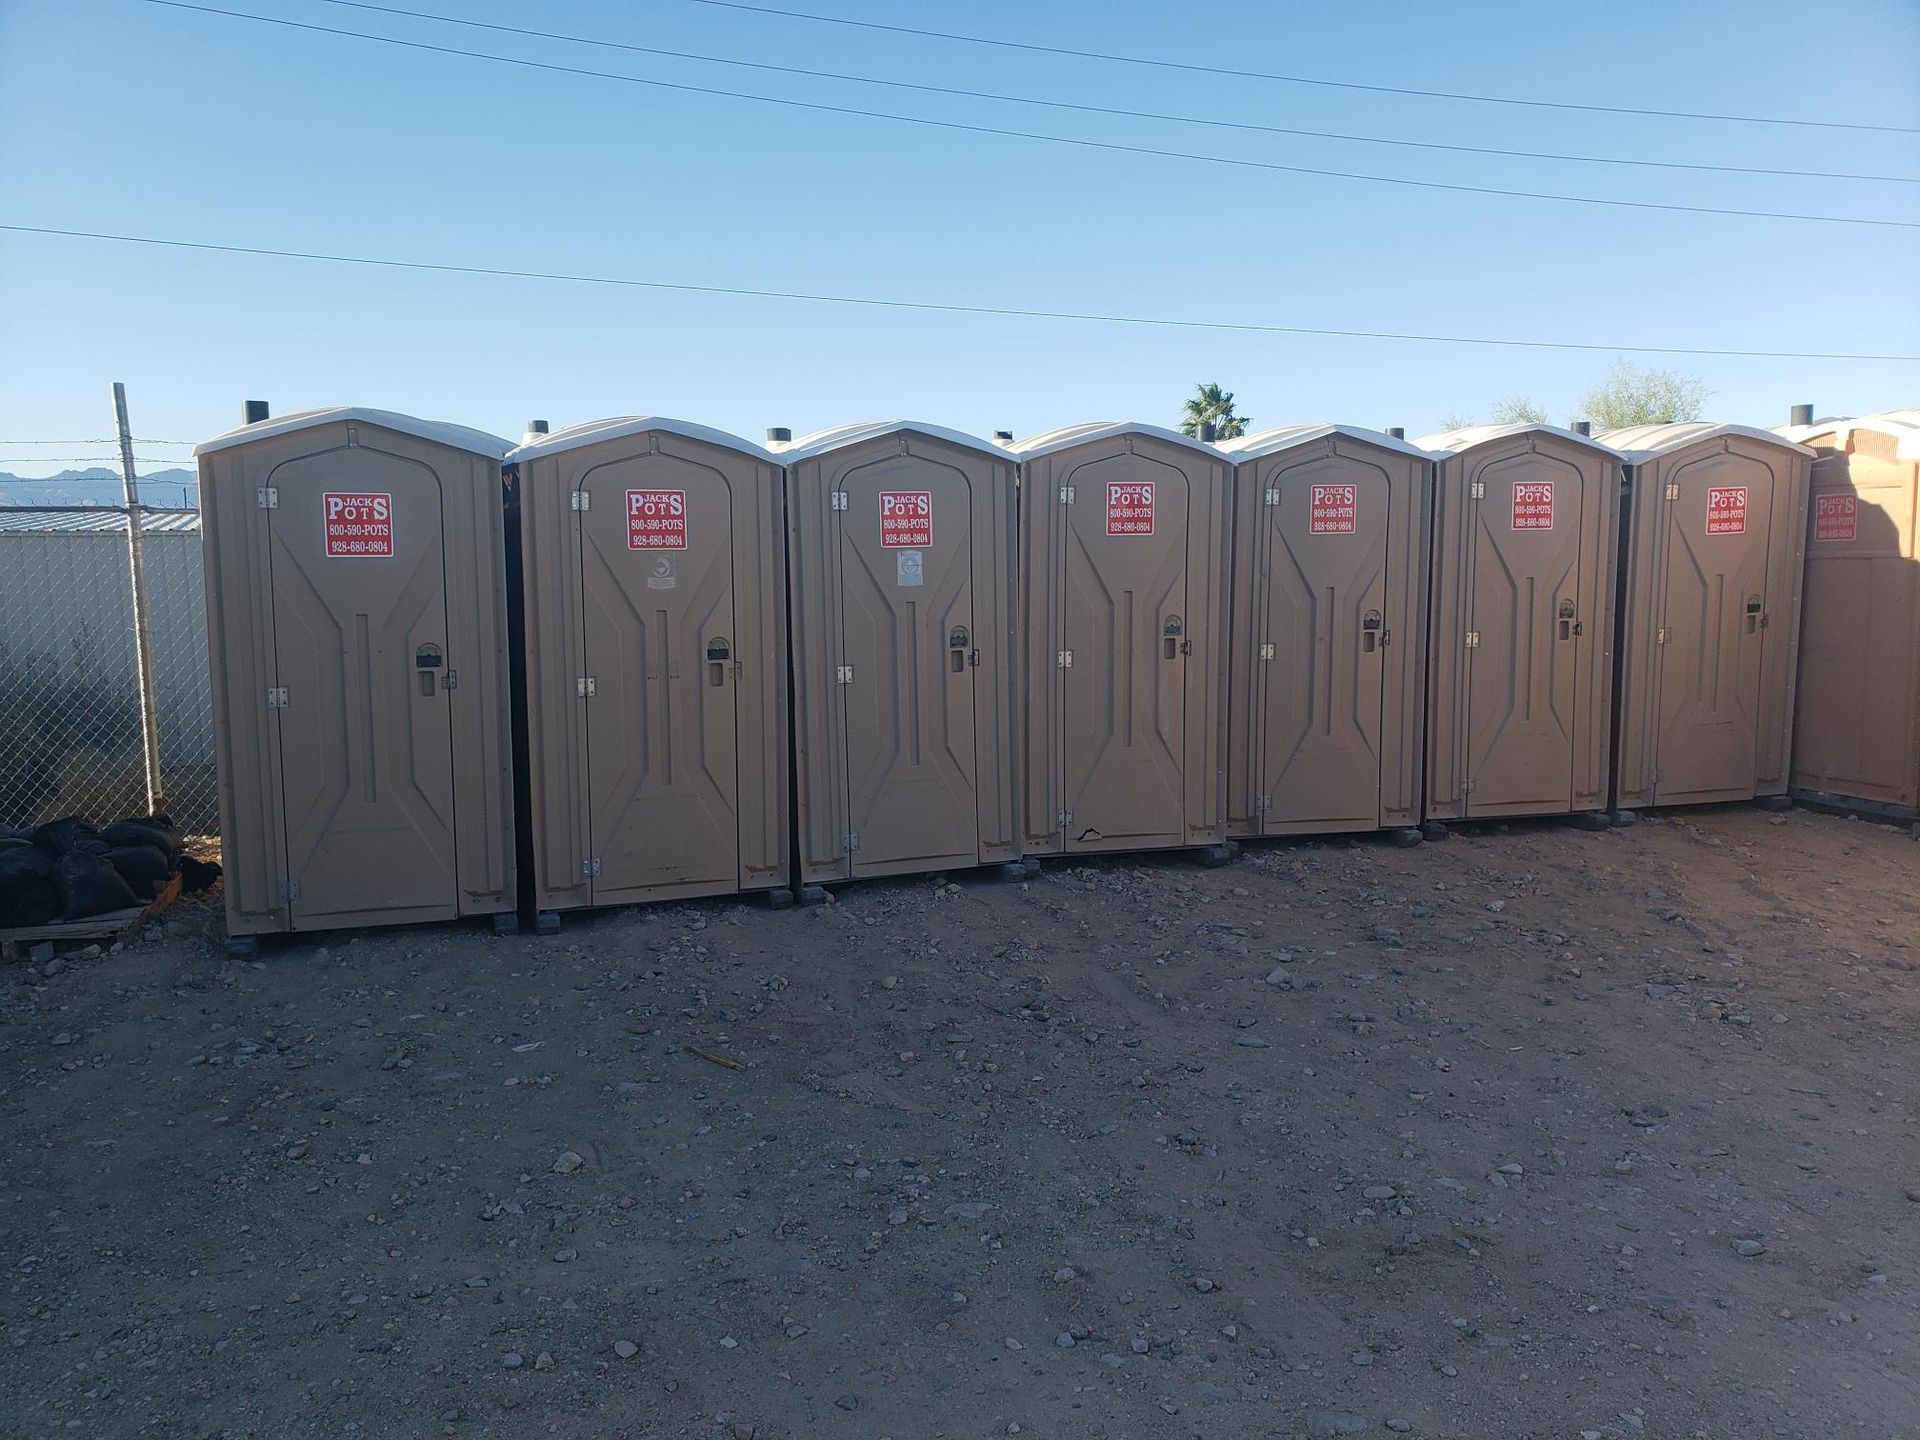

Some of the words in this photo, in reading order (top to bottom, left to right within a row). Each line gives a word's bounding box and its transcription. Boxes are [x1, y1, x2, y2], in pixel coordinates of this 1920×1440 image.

[1110, 487, 1151, 504] POTS
[1314, 487, 1353, 504] POTS
[1515, 486, 1551, 502] POTS
[1710, 490, 1745, 507] POTS
[344, 498, 373, 506] JACK
[630, 495, 682, 515] POTS
[883, 496, 928, 515] POTS
[328, 498, 388, 520] POTS
[330, 525, 389, 535] 800-590-POTS
[631, 520, 683, 530] 800-590-POTS
[884, 519, 928, 528] 800-590-POTS
[633, 535, 682, 545] 928-680-0804
[886, 534, 928, 543] 928-680-0804
[332, 541, 388, 552] 928-680-0804
